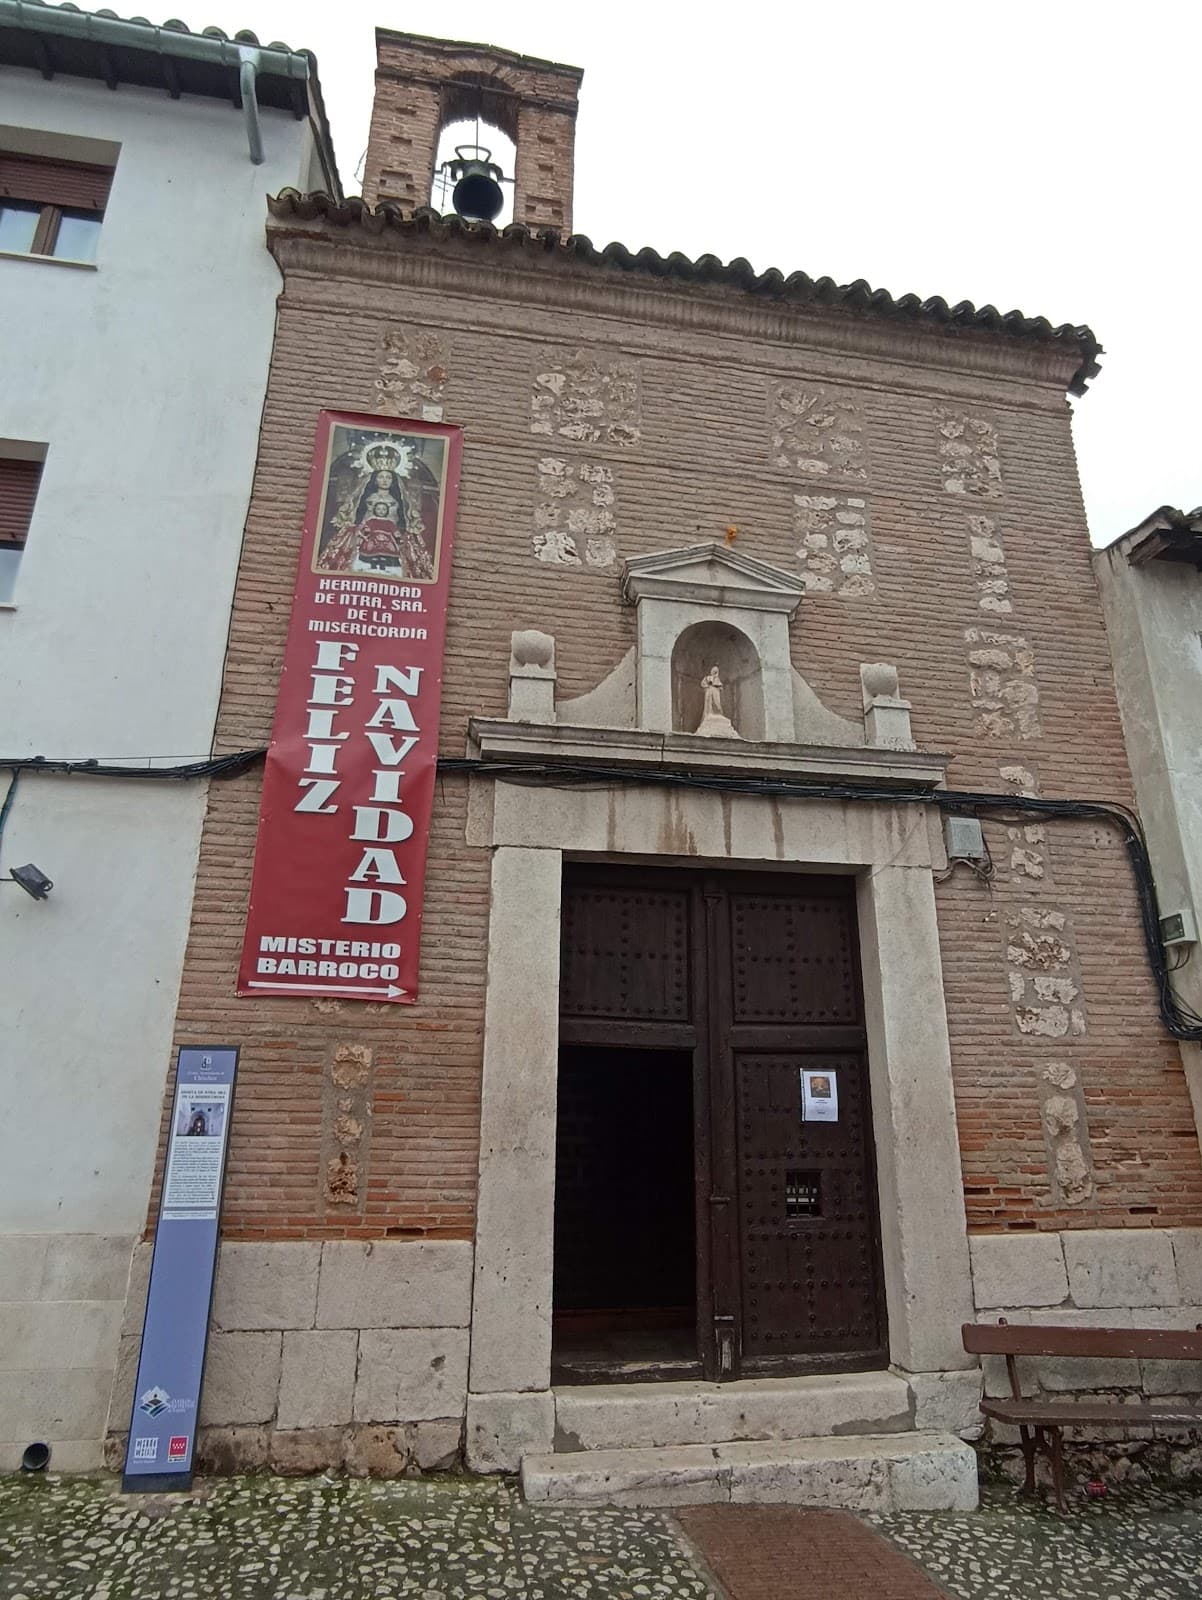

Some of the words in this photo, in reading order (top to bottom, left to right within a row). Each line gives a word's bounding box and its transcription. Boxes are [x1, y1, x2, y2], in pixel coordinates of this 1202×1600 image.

[319, 579, 422, 598] HERMANDAD
[314, 592, 336, 604] DE
[339, 594, 387, 609] NTRA.
[391, 599, 428, 612] SRA.
[347, 608, 368, 620] DE
[372, 611, 393, 623] LA
[308, 620, 428, 640] MISERICORDIA
[294, 640, 360, 814] FELIZ
[341, 665, 424, 925] NAVIDAD
[260, 935, 401, 959] MISTERIO
[257, 957, 400, 981] BARROCO
